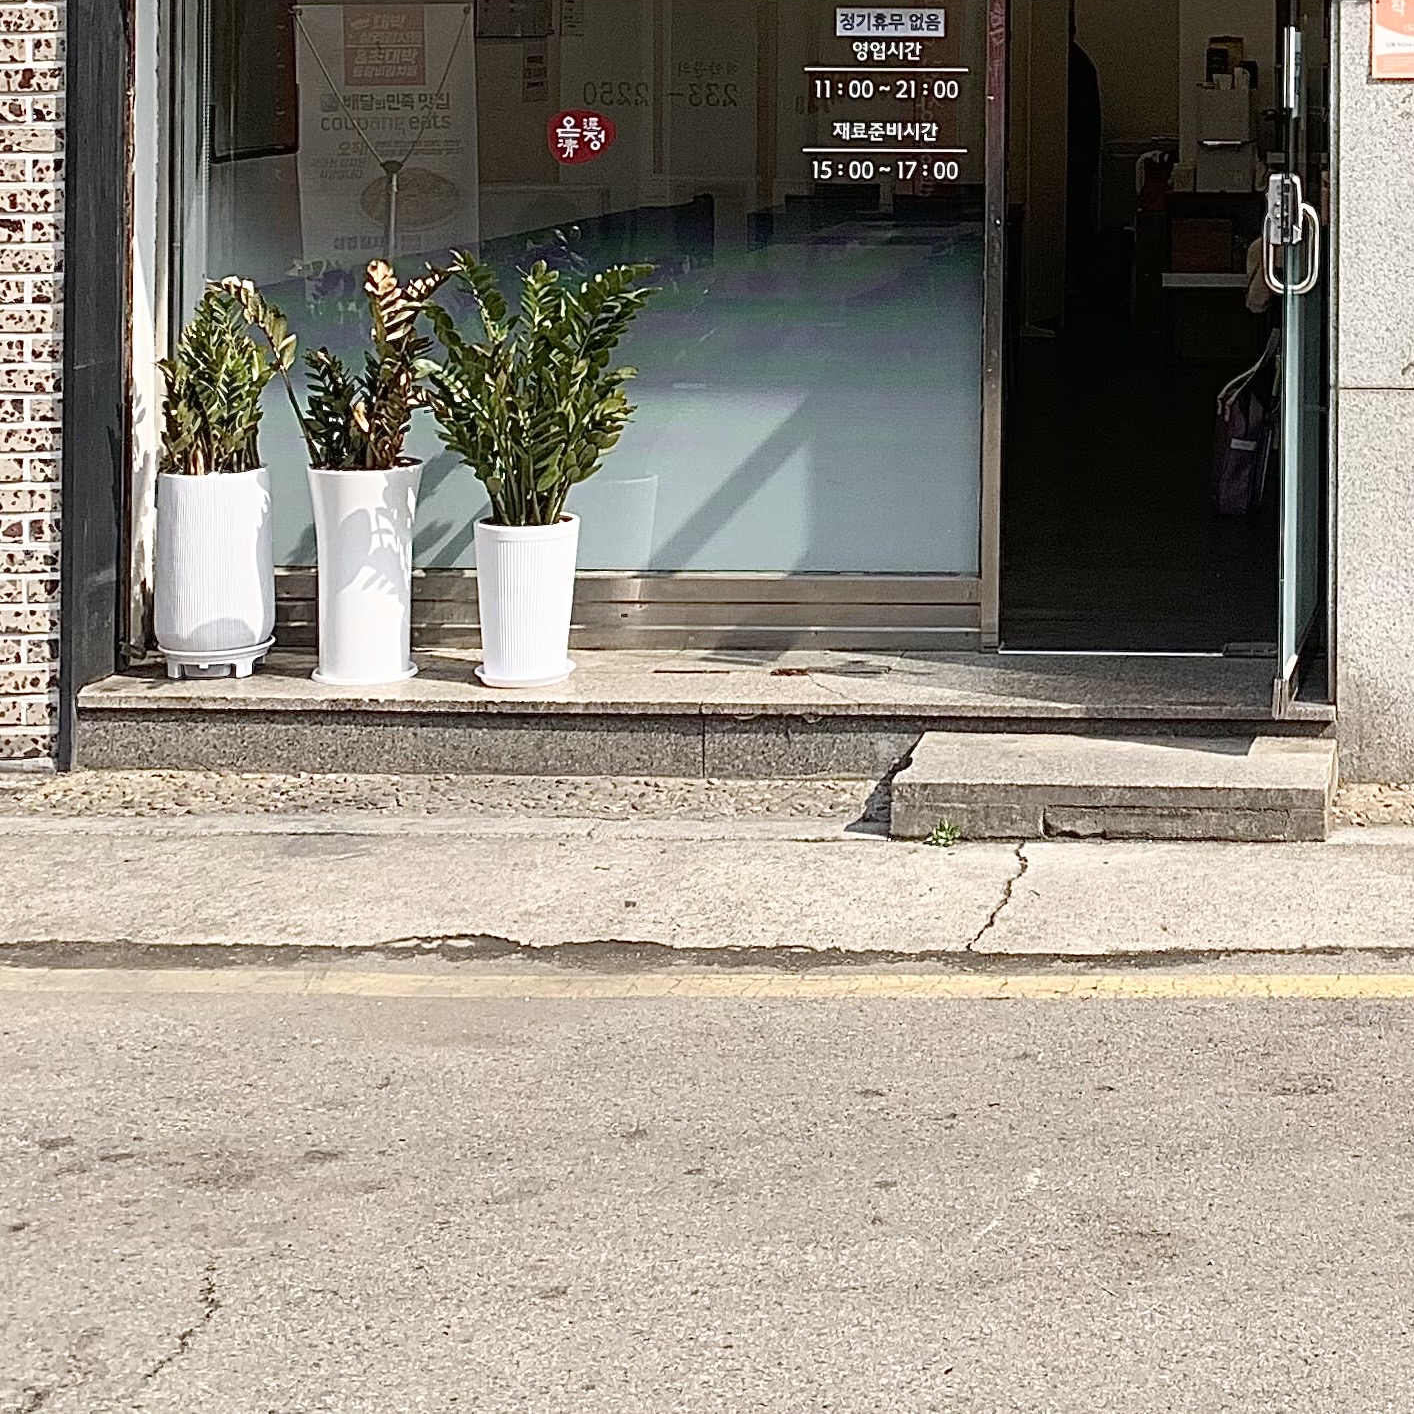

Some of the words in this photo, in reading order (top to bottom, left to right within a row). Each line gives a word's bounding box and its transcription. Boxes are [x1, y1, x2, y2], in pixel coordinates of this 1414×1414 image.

[840, 13, 904, 31] 정기휴무
[909, 13, 941, 32] 없음
[852, 42, 922, 61] 영업시간
[832, 122, 939, 142] 재료준비시간
